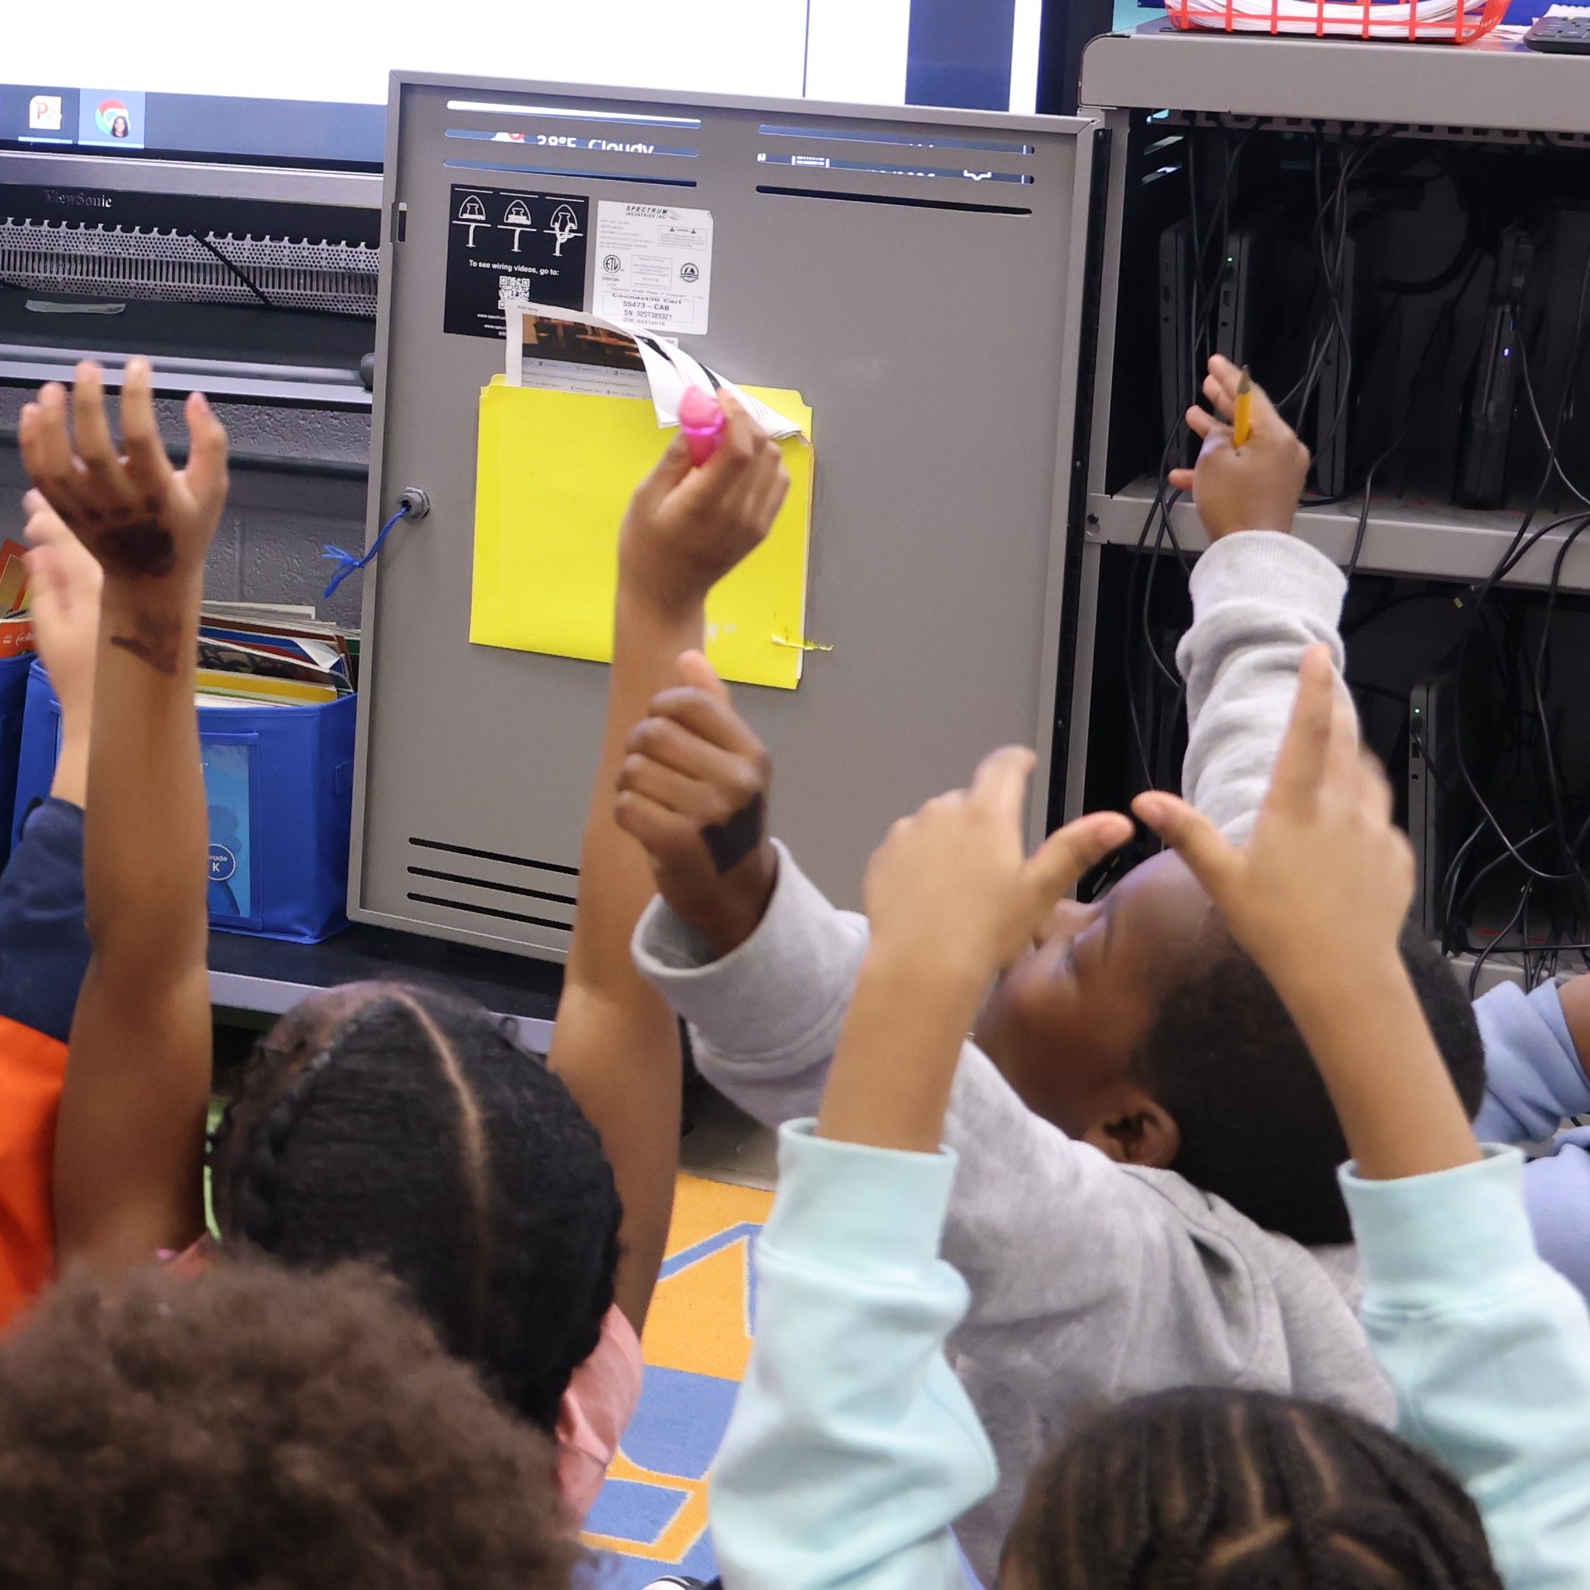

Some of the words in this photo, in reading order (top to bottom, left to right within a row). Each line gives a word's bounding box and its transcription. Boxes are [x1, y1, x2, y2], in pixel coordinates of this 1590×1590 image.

[43, 189, 113, 208] ViewSonic
[626, 205, 668, 215] SPECTRUM
[469, 259, 478, 268] To
[478, 261, 490, 269] see
[492, 262, 512, 272] wiring
[514, 265, 539, 275] videos,
[539, 268, 549, 276] go
[653, 303, 670, 311] CAB
[208, 854, 228, 862] rade
[211, 862, 220, 872] K
